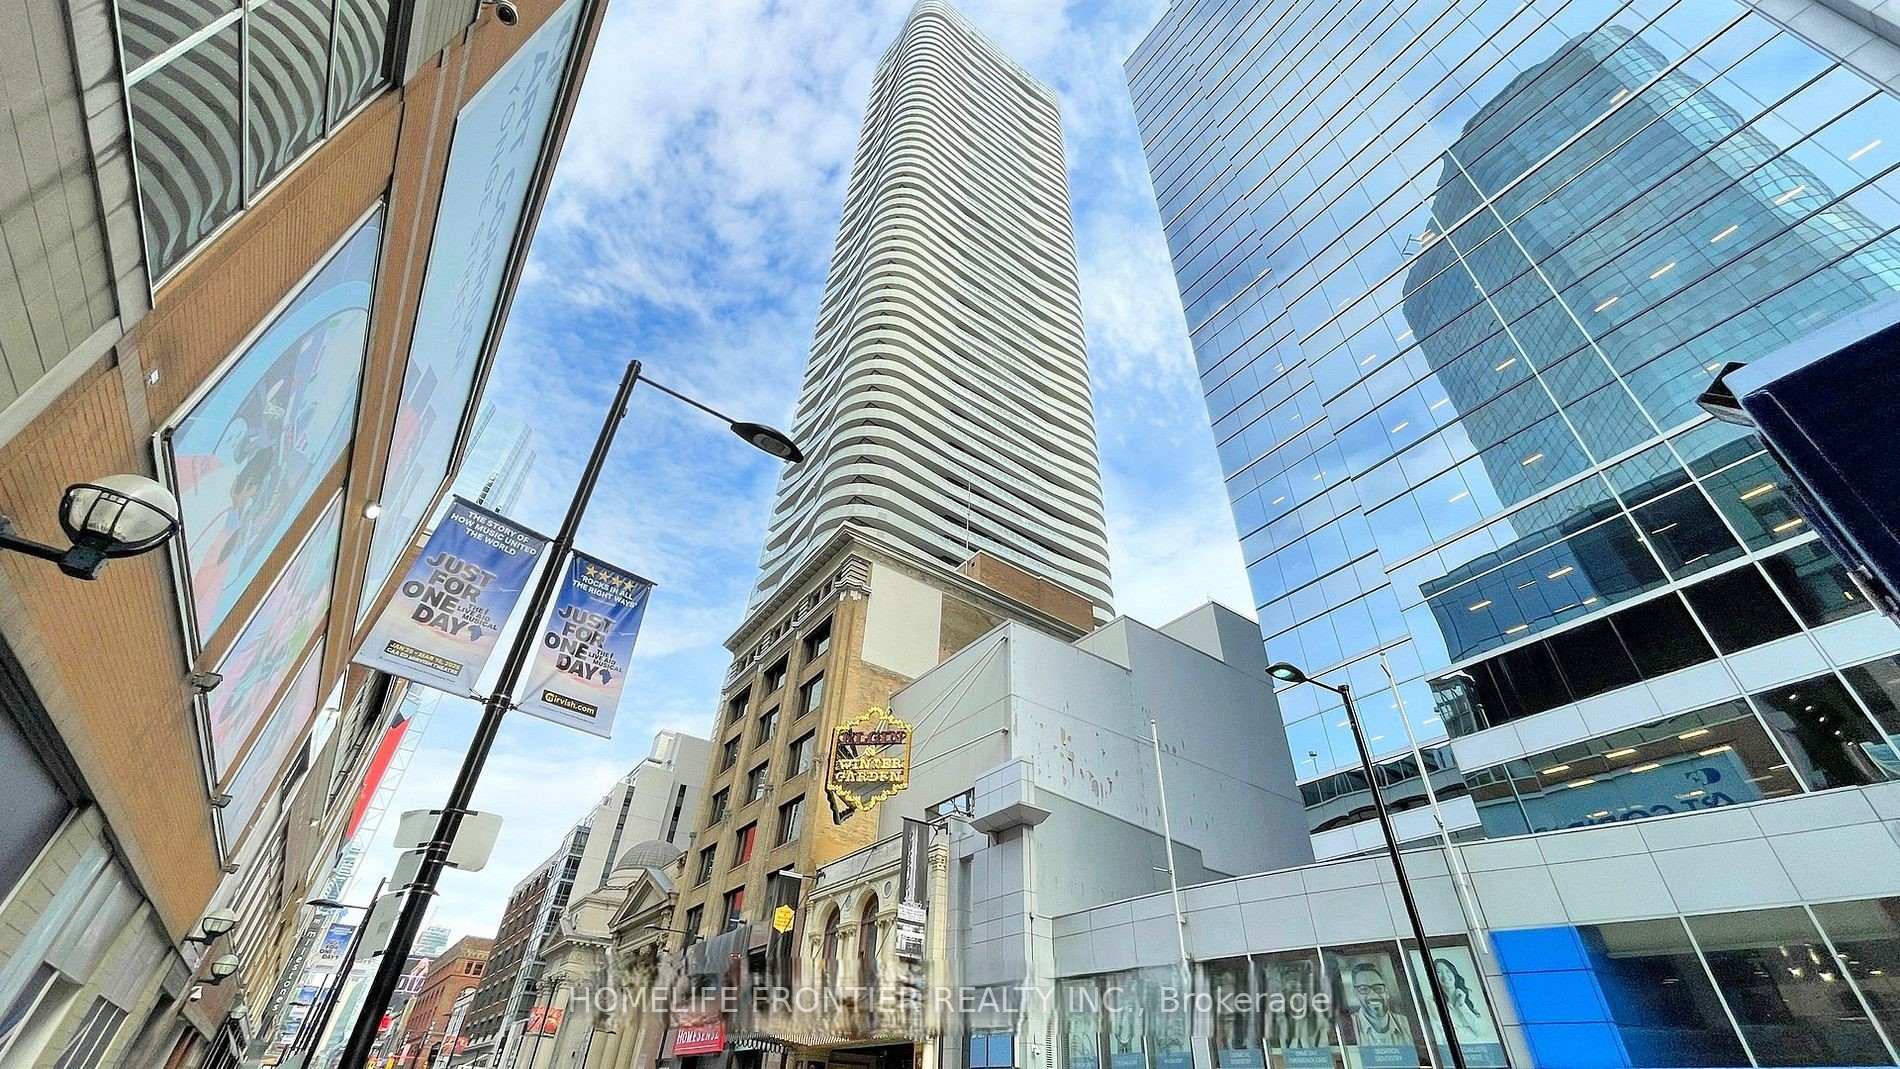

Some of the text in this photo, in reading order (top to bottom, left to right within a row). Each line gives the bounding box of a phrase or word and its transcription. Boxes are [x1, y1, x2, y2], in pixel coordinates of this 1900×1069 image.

[450, 512, 536, 555] HOW MUSIC UNITED
[466, 527, 516, 556] THE WORLD
[468, 511, 530, 544] THE STORY OF
[426, 551, 497, 587] JUST
[402, 580, 460, 614] ONE
[428, 569, 481, 603] FOR
[572, 580, 588, 592] THE
[588, 586, 613, 601] RIGHT
[610, 587, 620, 596] IN
[619, 589, 633, 600] ALL
[411, 602, 469, 636] DAY
[462, 613, 498, 630] MUSICAL
[558, 604, 617, 633] JUST
[544, 632, 590, 661] ONE
[562, 622, 606, 649] FOR
[555, 653, 600, 681] DAY
[835, 770, 902, 782] GARDEN
